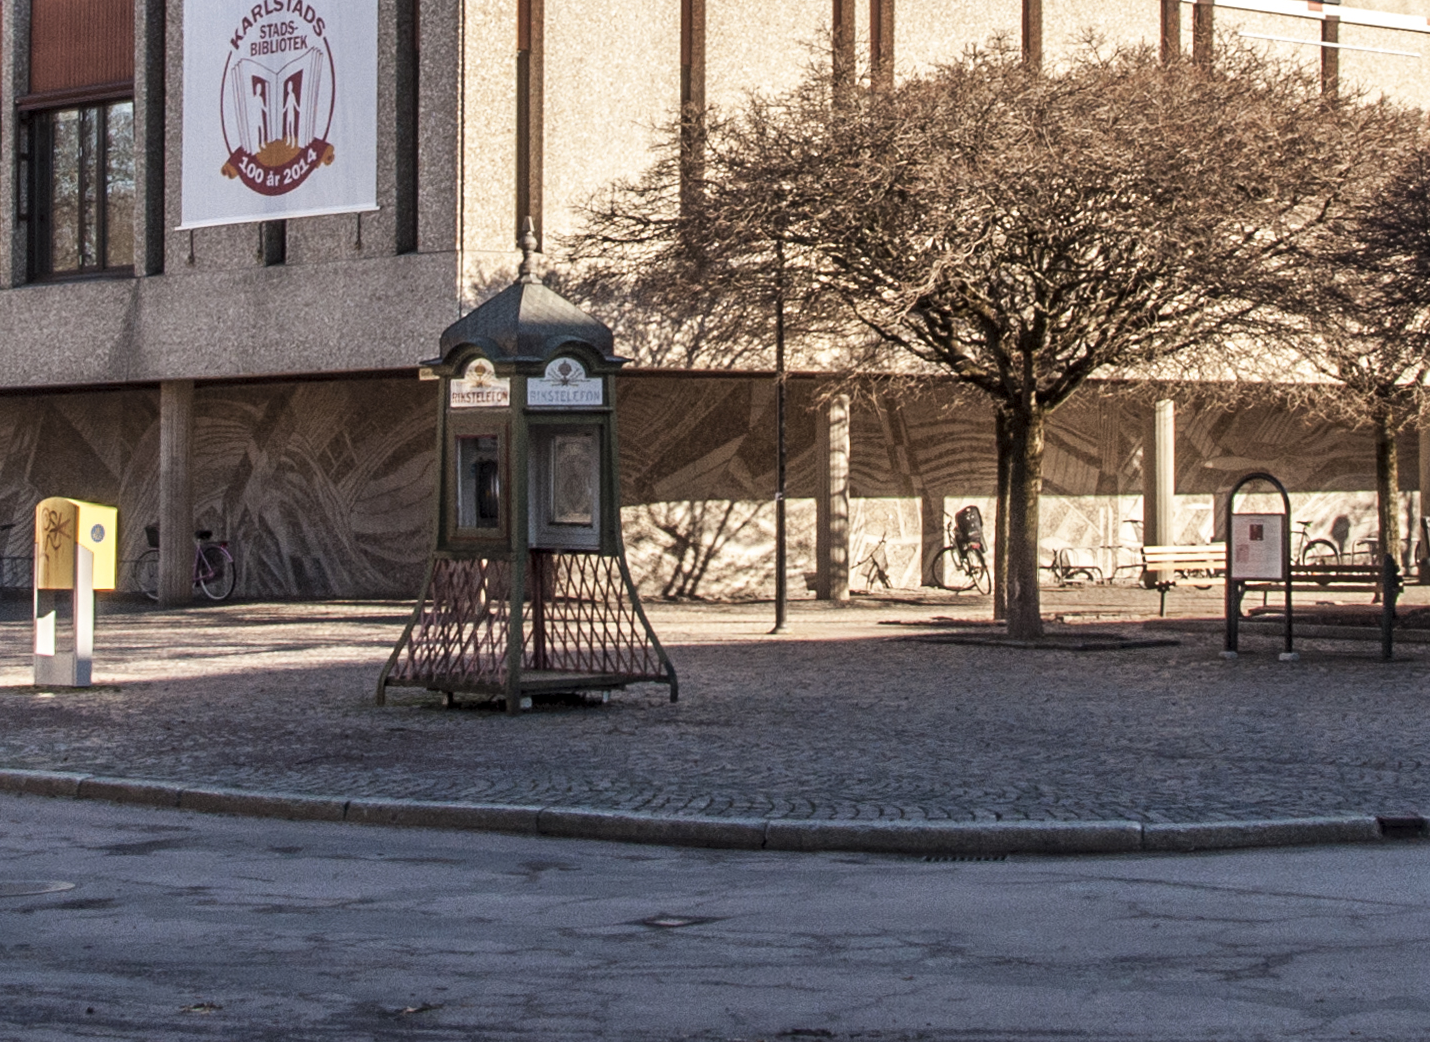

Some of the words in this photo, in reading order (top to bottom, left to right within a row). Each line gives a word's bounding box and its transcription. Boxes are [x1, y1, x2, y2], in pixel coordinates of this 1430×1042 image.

[259, 20, 298, 39] STADS-
[250, 35, 308, 57] BIBLIOTEK
[238, 155, 264, 184] 100
[266, 170, 279, 187] år
[283, 147, 317, 188] 2014
[530, 390, 600, 402] RIKSTELEFON
